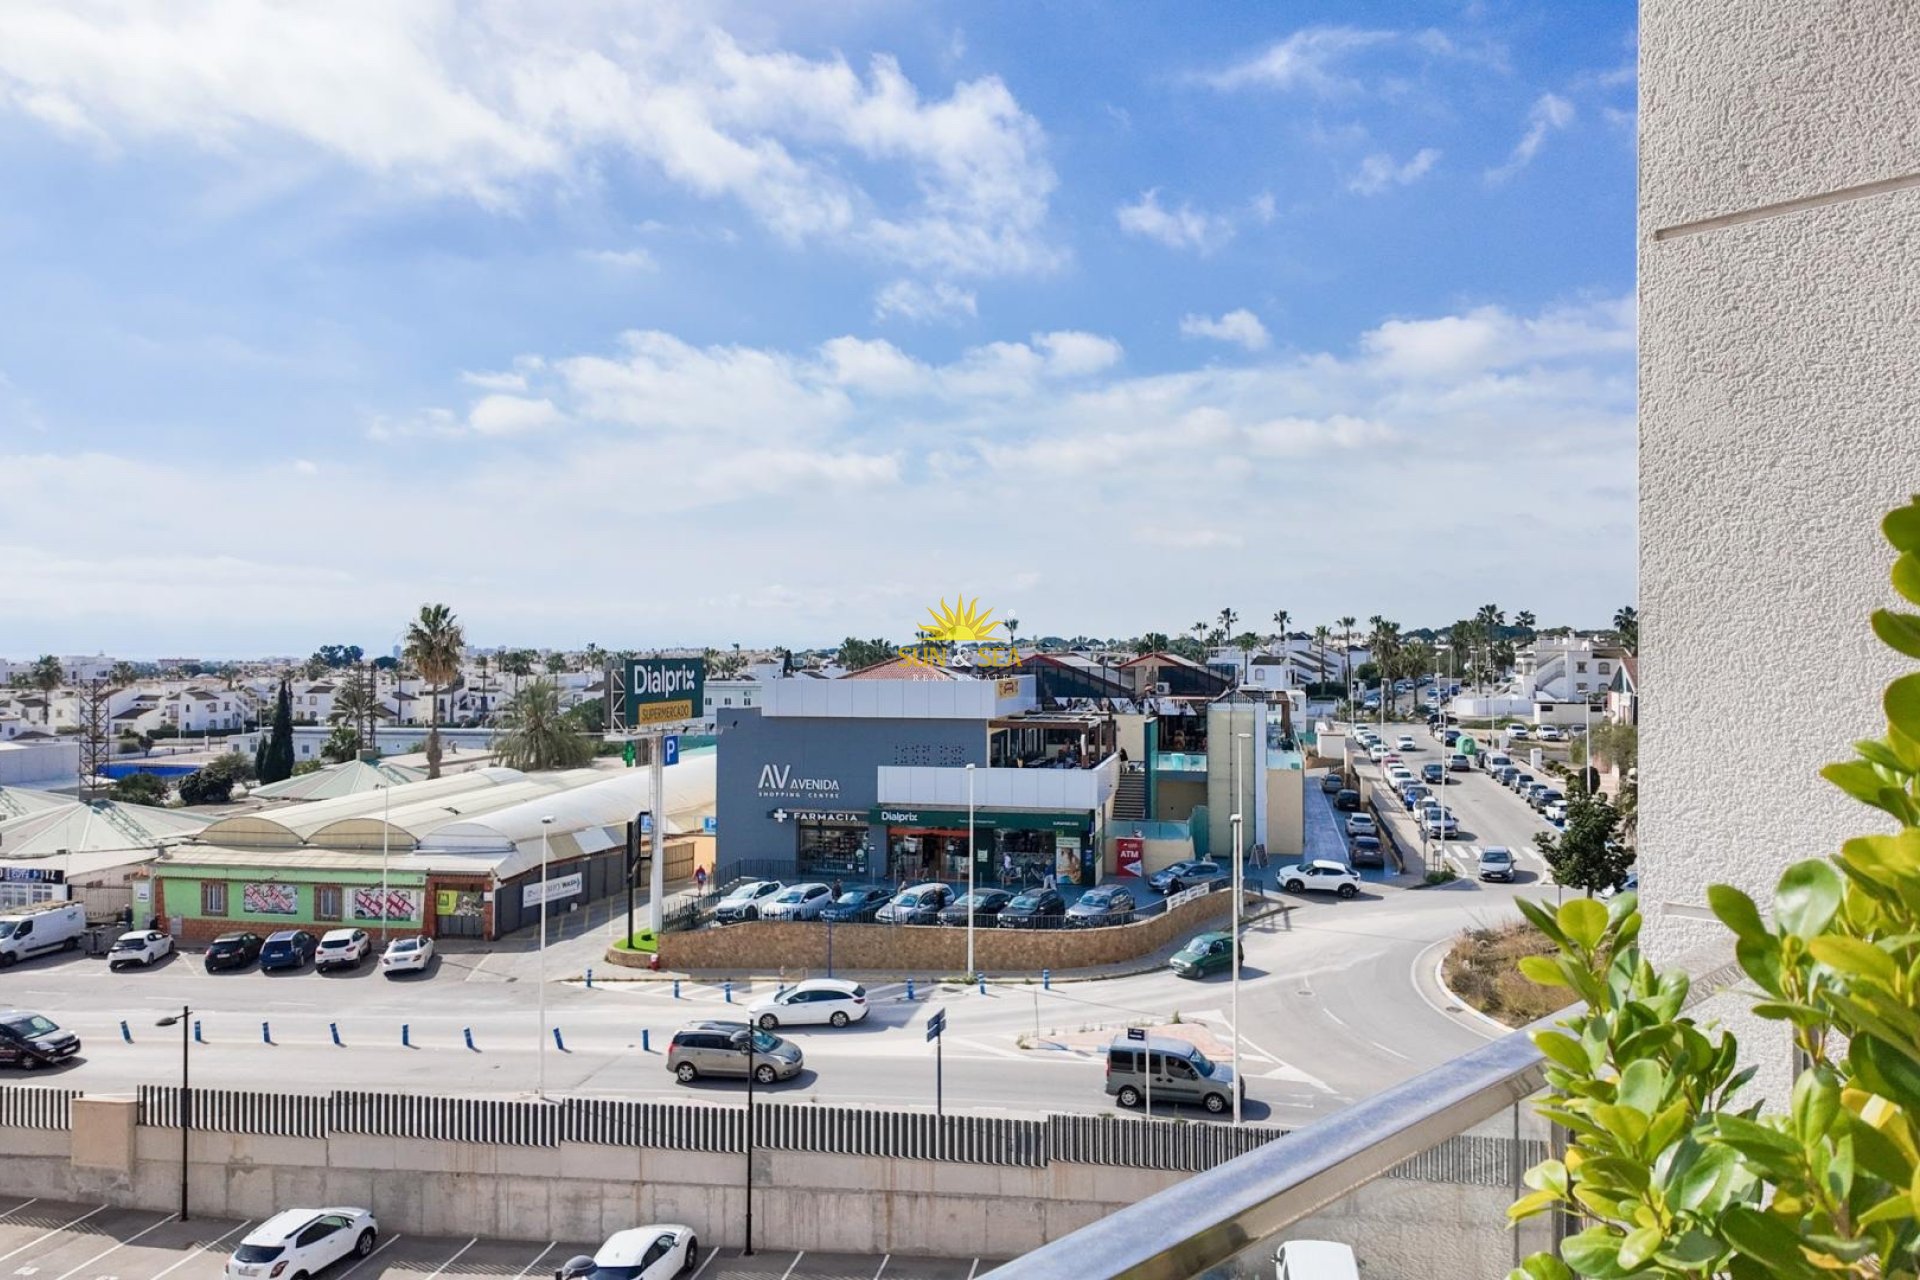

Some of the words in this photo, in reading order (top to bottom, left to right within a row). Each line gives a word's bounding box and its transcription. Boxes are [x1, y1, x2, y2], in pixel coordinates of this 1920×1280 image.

[634, 664, 696, 699] Dialprix
[641, 703, 690, 721] SUPERMERCADO
[666, 739, 676, 763] P
[758, 764, 791, 789] AV
[789, 778, 840, 791] AVENIDA
[793, 812, 859, 821] FARMACIA
[881, 811, 918, 823] Dialprix
[1120, 850, 1140, 859] ATM
